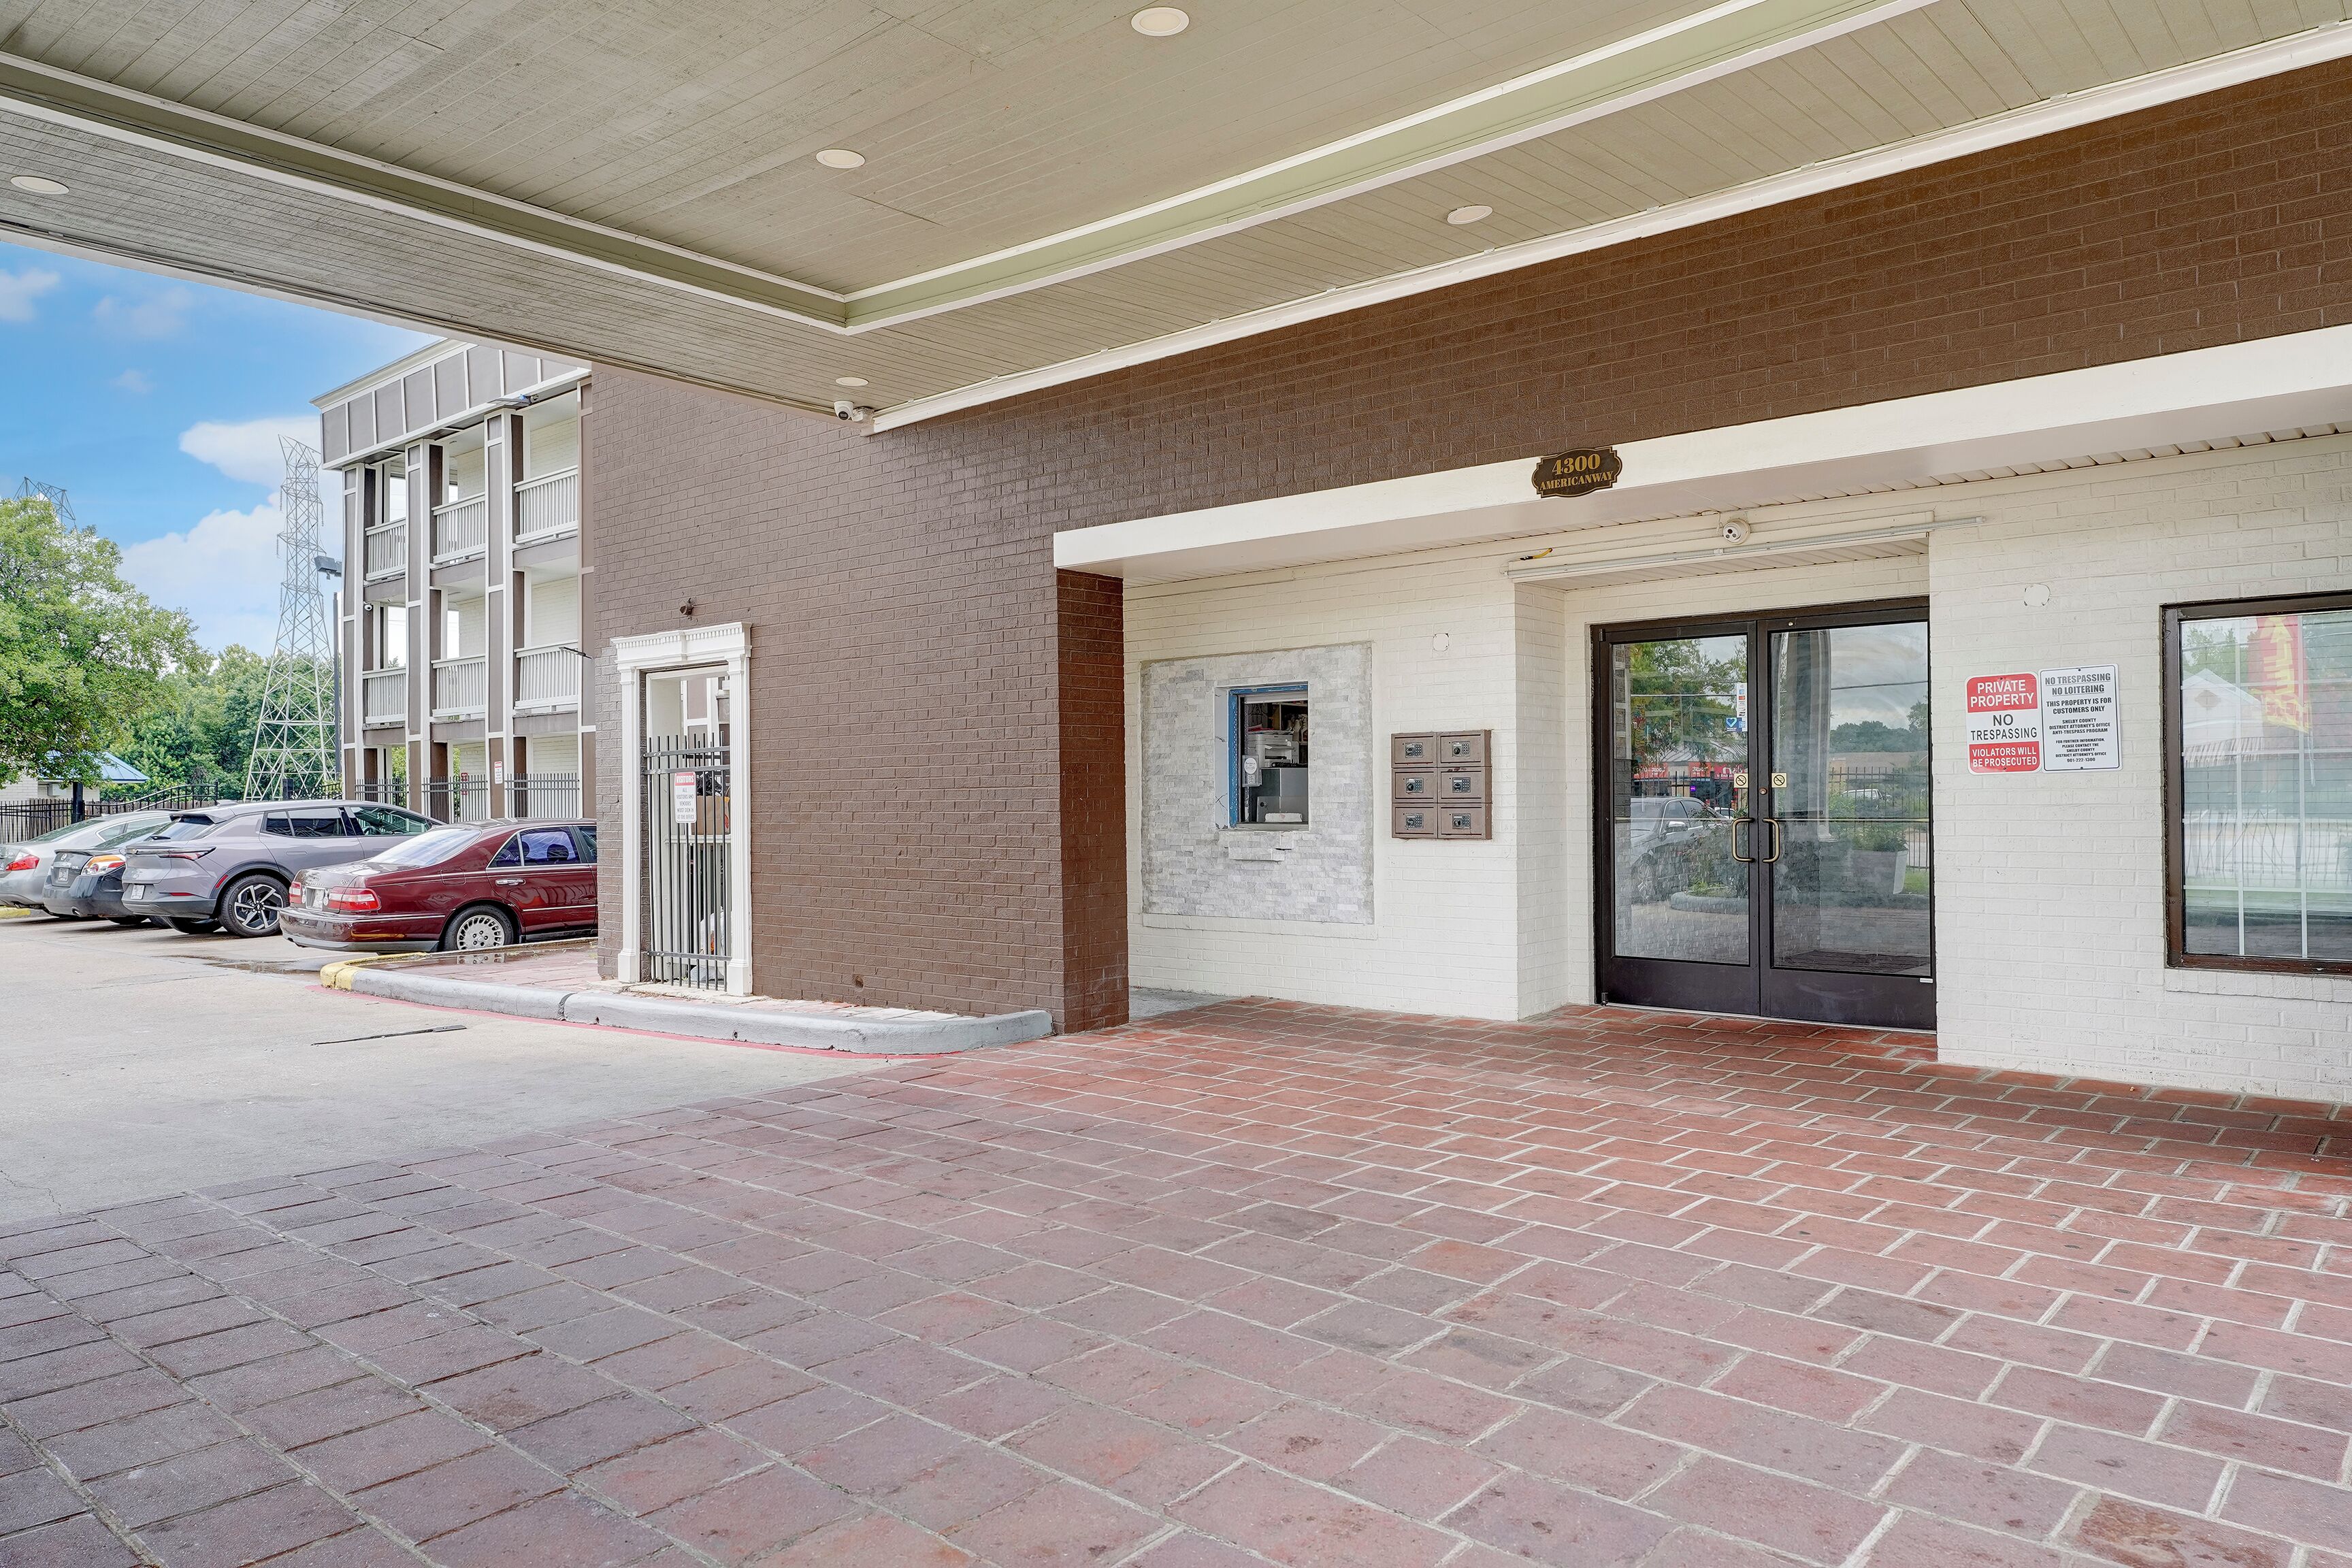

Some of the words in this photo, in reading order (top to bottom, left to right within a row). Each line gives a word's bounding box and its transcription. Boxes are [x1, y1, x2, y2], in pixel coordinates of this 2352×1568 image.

[1552, 454, 1601, 475] 4300
[2057, 673, 2110, 684] TRESPASSING
[1977, 680, 2025, 693] PRIVATE
[2065, 685, 2104, 694] LOITERING
[1971, 693, 2034, 707] PROPERTY
[1993, 714, 2013, 726] NO
[1971, 728, 2037, 740] TRESPASSING
[1972, 748, 2015, 757] VIOLATORS
[2017, 747, 2036, 755] WILL
[1973, 759, 1982, 767] BE
[1985, 757, 2037, 766] PROSECUTED
